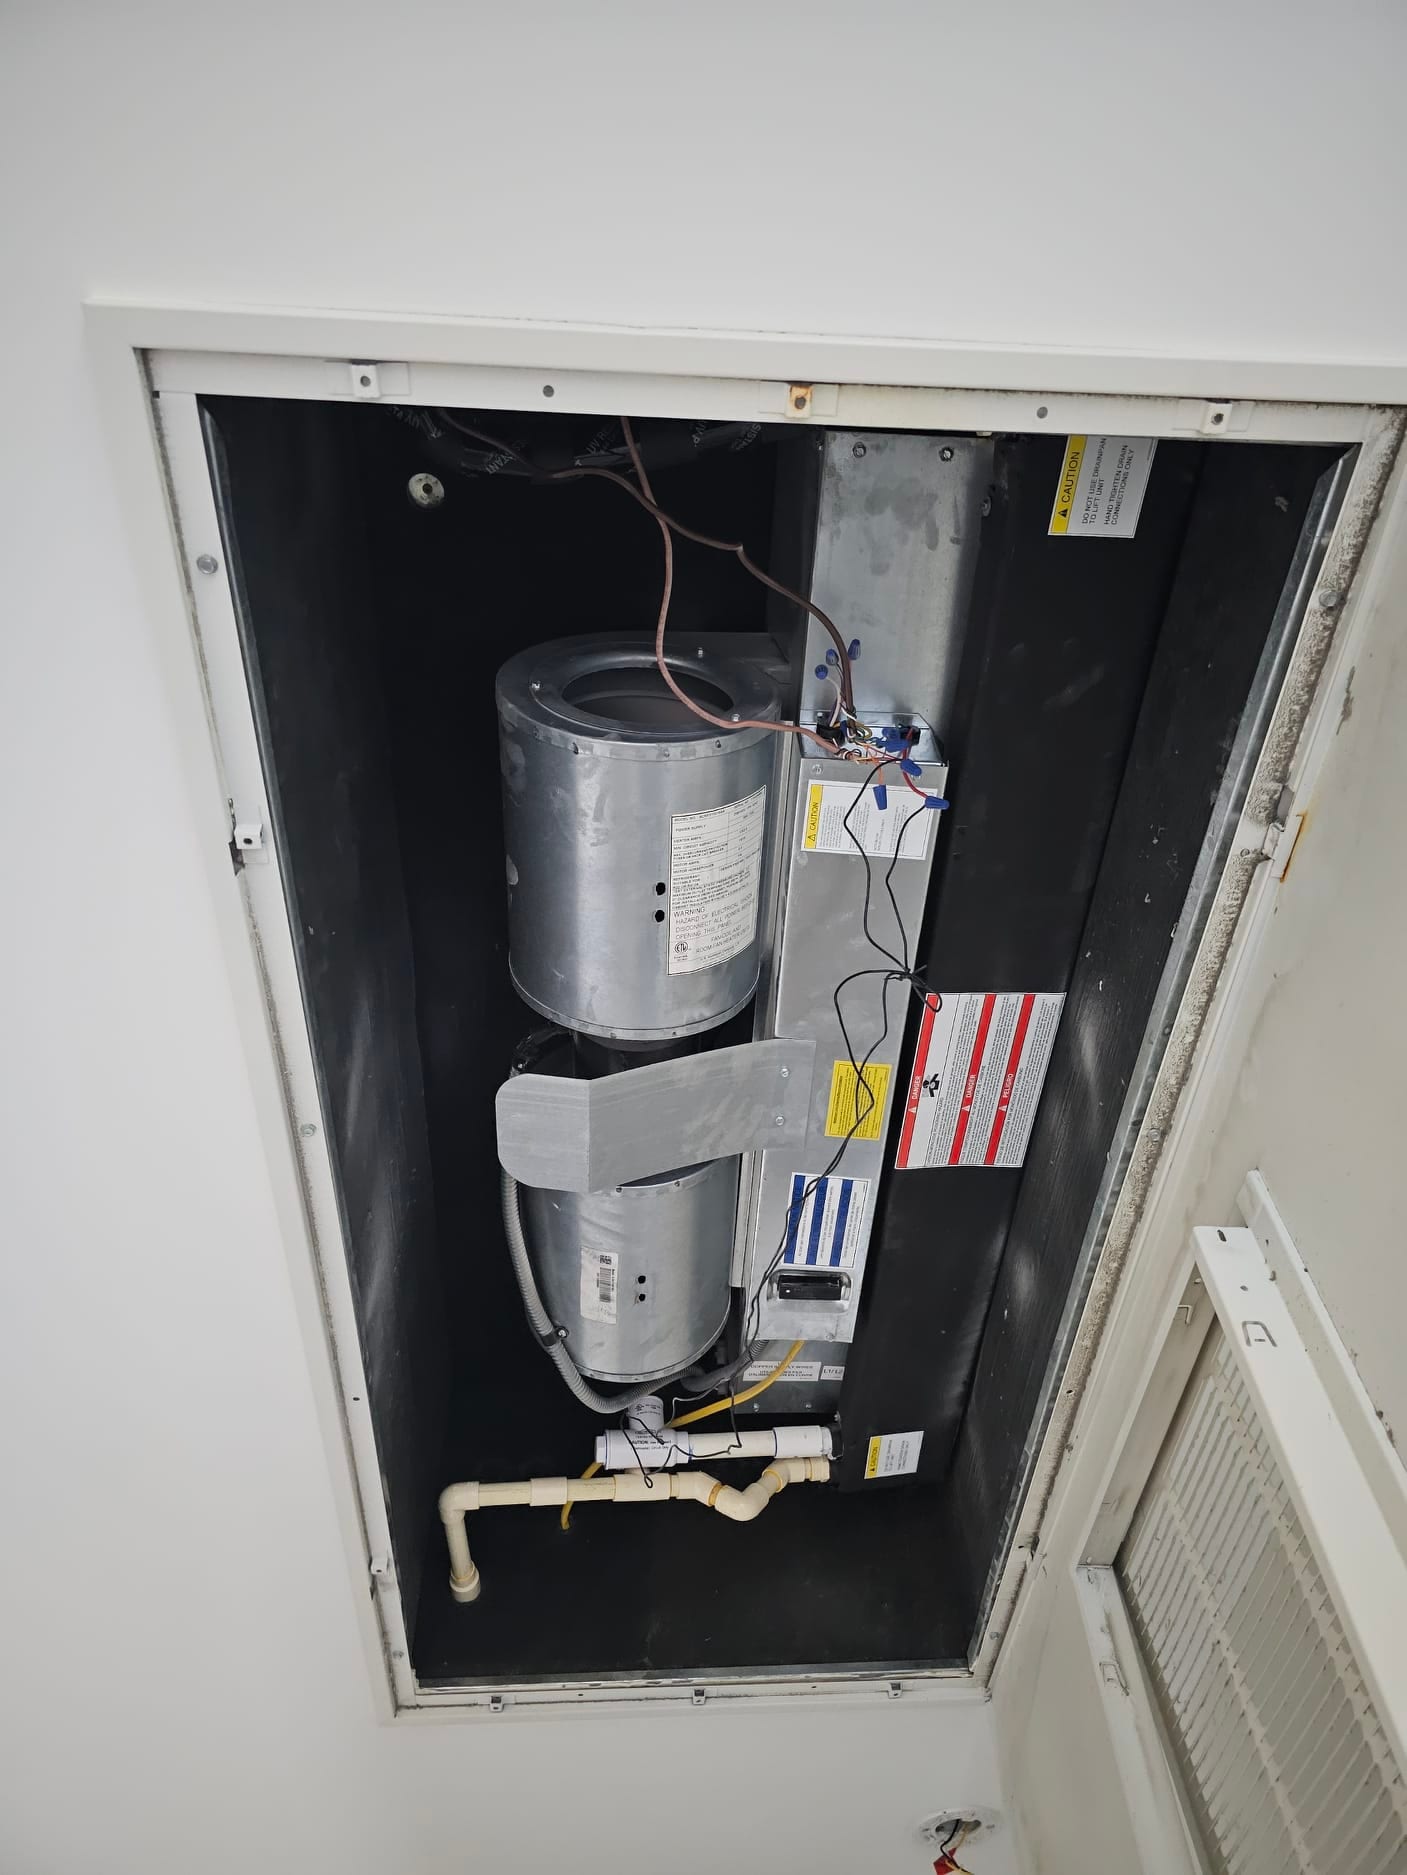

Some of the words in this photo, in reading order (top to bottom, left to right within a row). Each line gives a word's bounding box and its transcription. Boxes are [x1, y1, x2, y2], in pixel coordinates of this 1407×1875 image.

[1062, 452, 1080, 503] CAUTION
[1089, 479, 1097, 494] USE
[1104, 505, 1113, 524] HAND
[1109, 470, 1121, 502] TIGHTEN
[1118, 445, 1128, 468] DRAIN
[1111, 472, 1128, 525] CONNECTIONS
[1125, 449, 1134, 469] ONLY
[1085, 497, 1093, 511] NOT
[1089, 515, 1097, 524] TO
[1096, 479, 1105, 495] UNIT
[1082, 513, 1089, 524] DO
[810, 802, 818, 830] CAUTION
[674, 906, 705, 918] WARNING
[676, 916, 699, 924] HAZARD
[912, 1076, 921, 1100] DANGER
[966, 1074, 976, 1098] DANGER
[1003, 1073, 1014, 1098] PELIGRO
